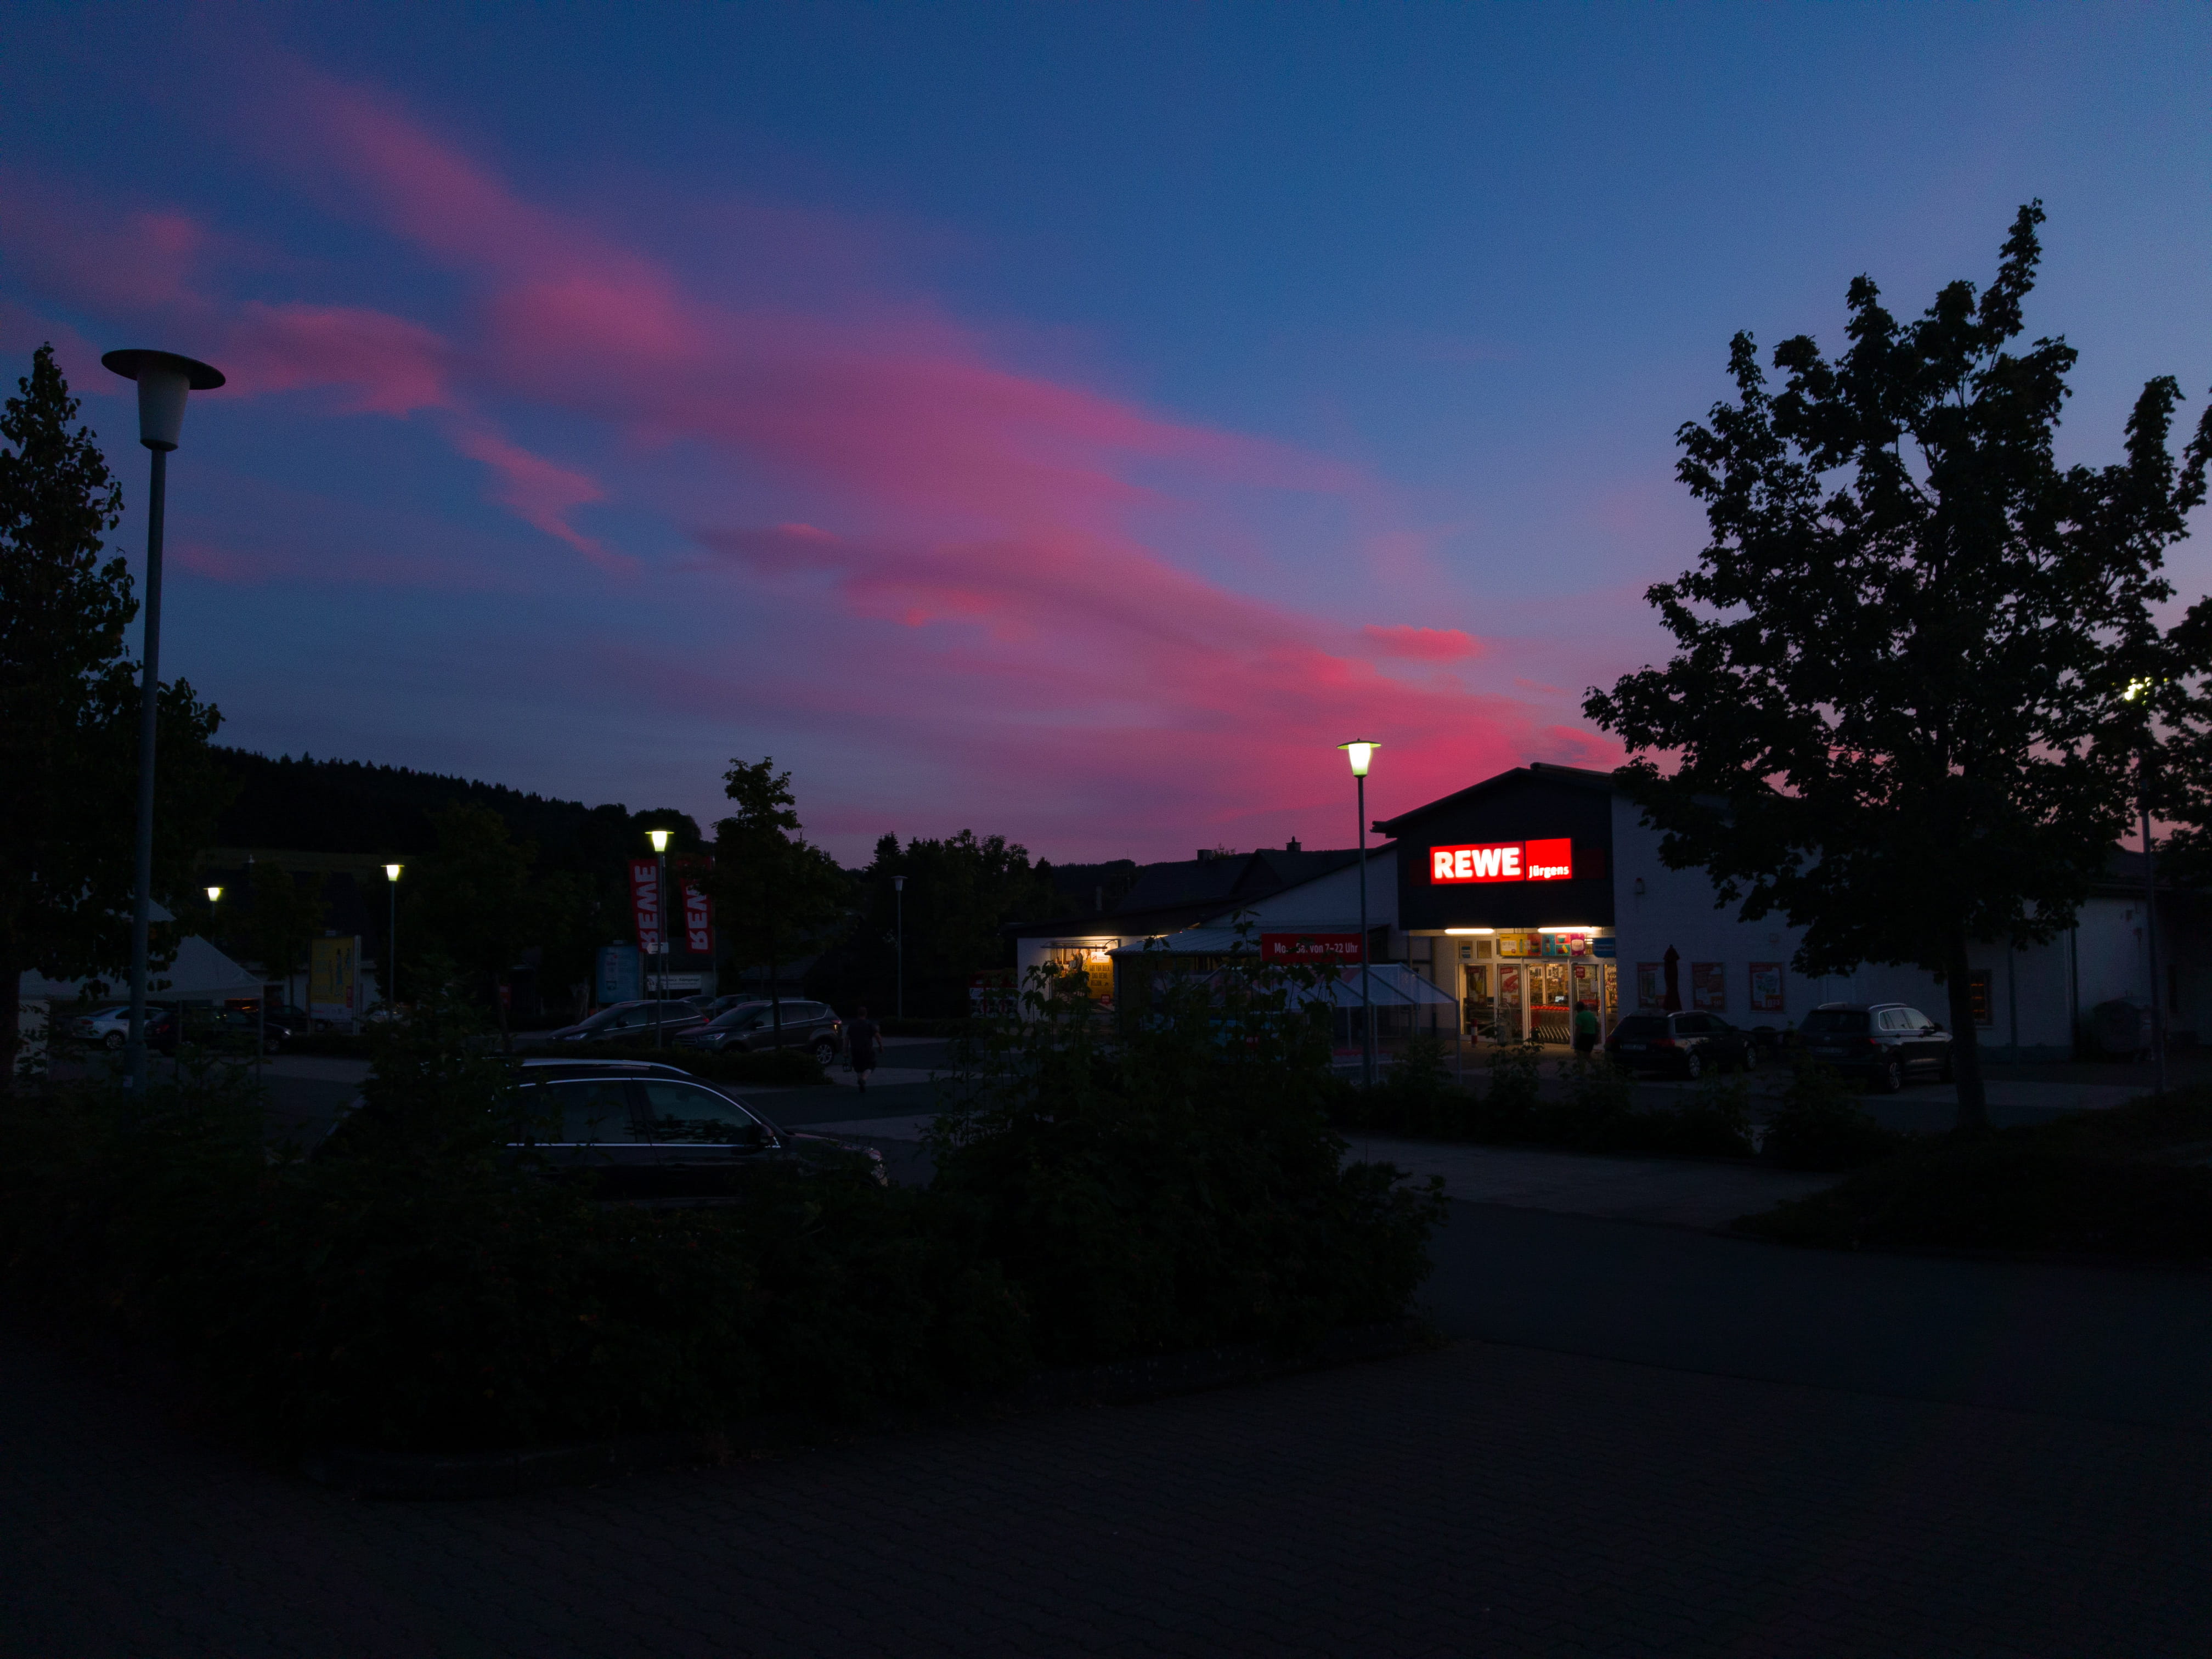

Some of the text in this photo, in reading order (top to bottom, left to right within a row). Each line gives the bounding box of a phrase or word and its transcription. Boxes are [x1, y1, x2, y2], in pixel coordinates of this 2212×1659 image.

[1434, 848, 1520, 878] REWE
[1274, 942, 1289, 953] Mo.
[1310, 945, 1323, 953] von
[1345, 942, 1358, 953] Uhr
